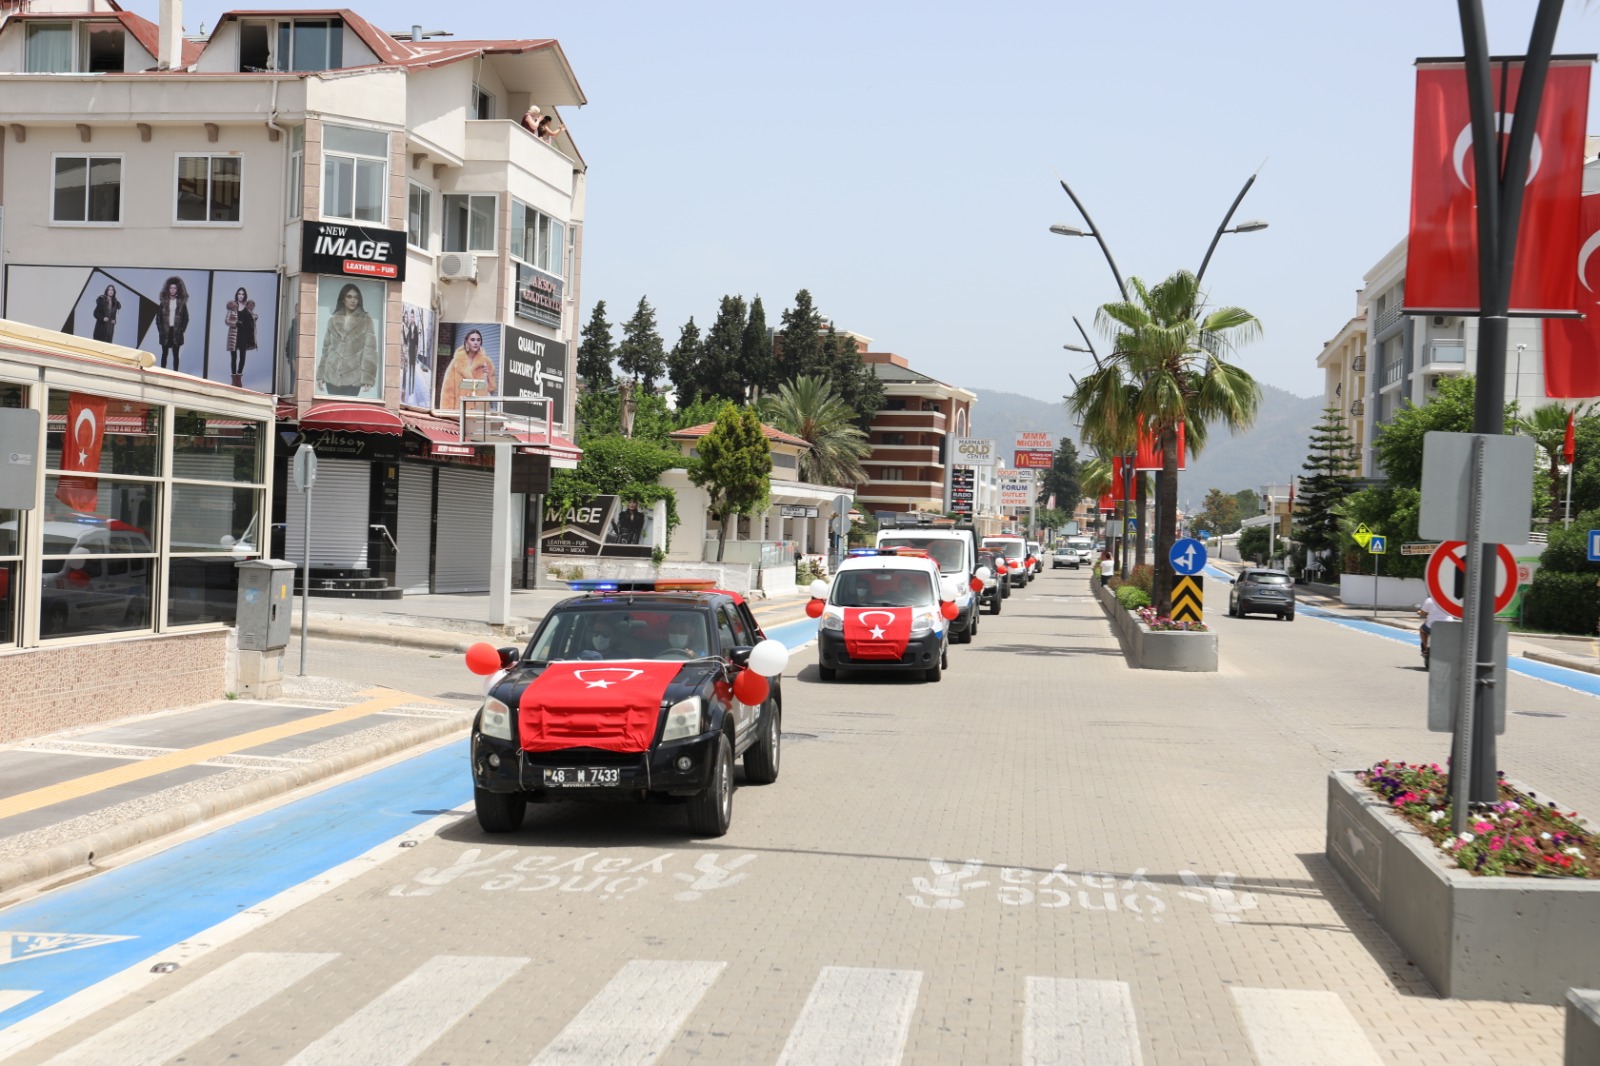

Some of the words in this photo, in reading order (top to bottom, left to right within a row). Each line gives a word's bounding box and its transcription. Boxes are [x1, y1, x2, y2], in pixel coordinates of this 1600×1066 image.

[325, 226, 348, 237] NEW
[314, 235, 390, 261] IMAGE
[346, 262, 375, 271] LEATHER
[518, 336, 545, 357] QUALITY
[509, 359, 534, 379] LUXURY
[312, 432, 365, 454] Aksoy
[959, 444, 990, 455] GOLD
[551, 770, 565, 783] 48
[590, 769, 618, 782] 7433
